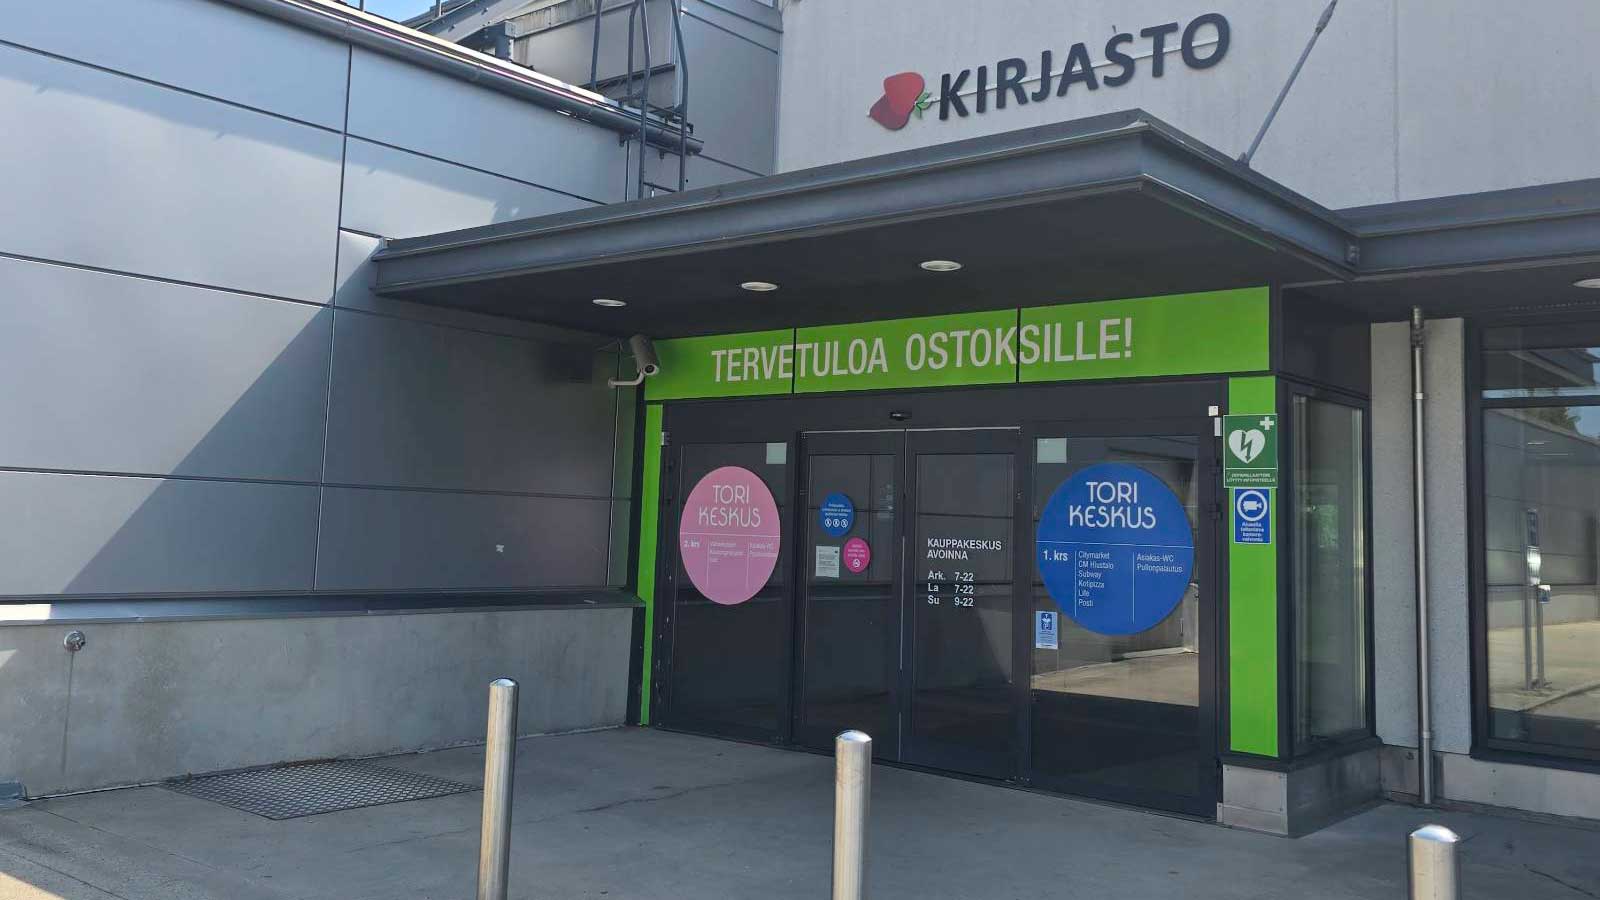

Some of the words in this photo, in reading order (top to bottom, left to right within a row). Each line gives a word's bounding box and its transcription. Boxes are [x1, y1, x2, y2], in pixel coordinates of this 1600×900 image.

[939, 12, 1230, 120] KIRJASTO
[711, 337, 889, 383] TERVETULOA
[905, 317, 1132, 371] OSTOKSILLE!
[712, 484, 750, 504] TORI
[1086, 481, 1138, 504] TORI
[699, 506, 761, 528] KESKUS
[1069, 505, 1156, 529] KESKUS
[927, 538, 1002, 550] KAUPPAKESKUS
[927, 549, 968, 560] AVOINNA
[1043, 549, 1052, 560] 1.
[1053, 550, 1069, 561] krs
[1078, 550, 1110, 560] Citymarket
[1136, 553, 1174, 562] Asiakas-WC
[1136, 563, 1183, 573] Pullonpalautus
[927, 570, 946, 580] Ark.
[954, 571, 974, 582] 7-22
[1078, 570, 1102, 579] Subway
[927, 583, 939, 592] La
[954, 584, 974, 594] 7-22
[1078, 580, 1105, 588] Kotipizza
[1078, 589, 1090, 597] Life
[927, 595, 940, 604] Su
[954, 596, 974, 607] 9-22
[1078, 599, 1094, 607] Posti
